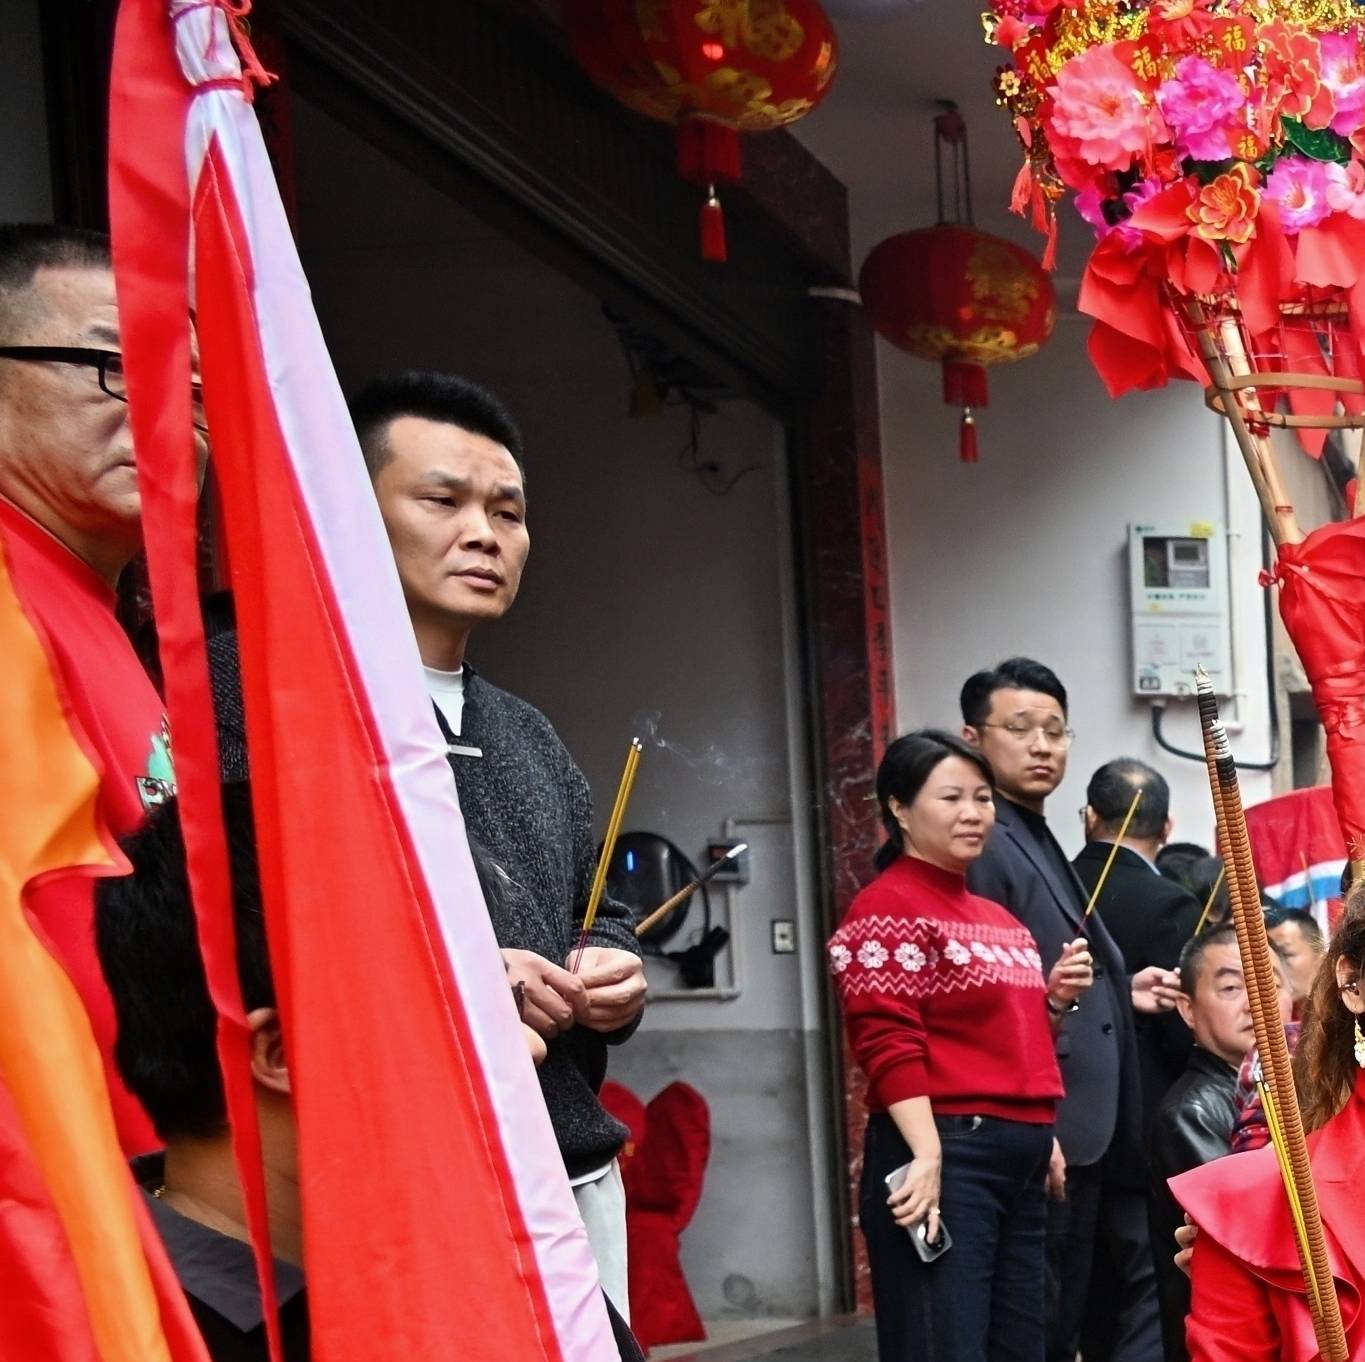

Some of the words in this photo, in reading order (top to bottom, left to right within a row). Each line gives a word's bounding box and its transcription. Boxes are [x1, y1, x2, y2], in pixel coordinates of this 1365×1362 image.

[1222, 24, 1247, 52] 福
[1130, 46, 1157, 81] 福
[1237, 136, 1258, 159] 福
